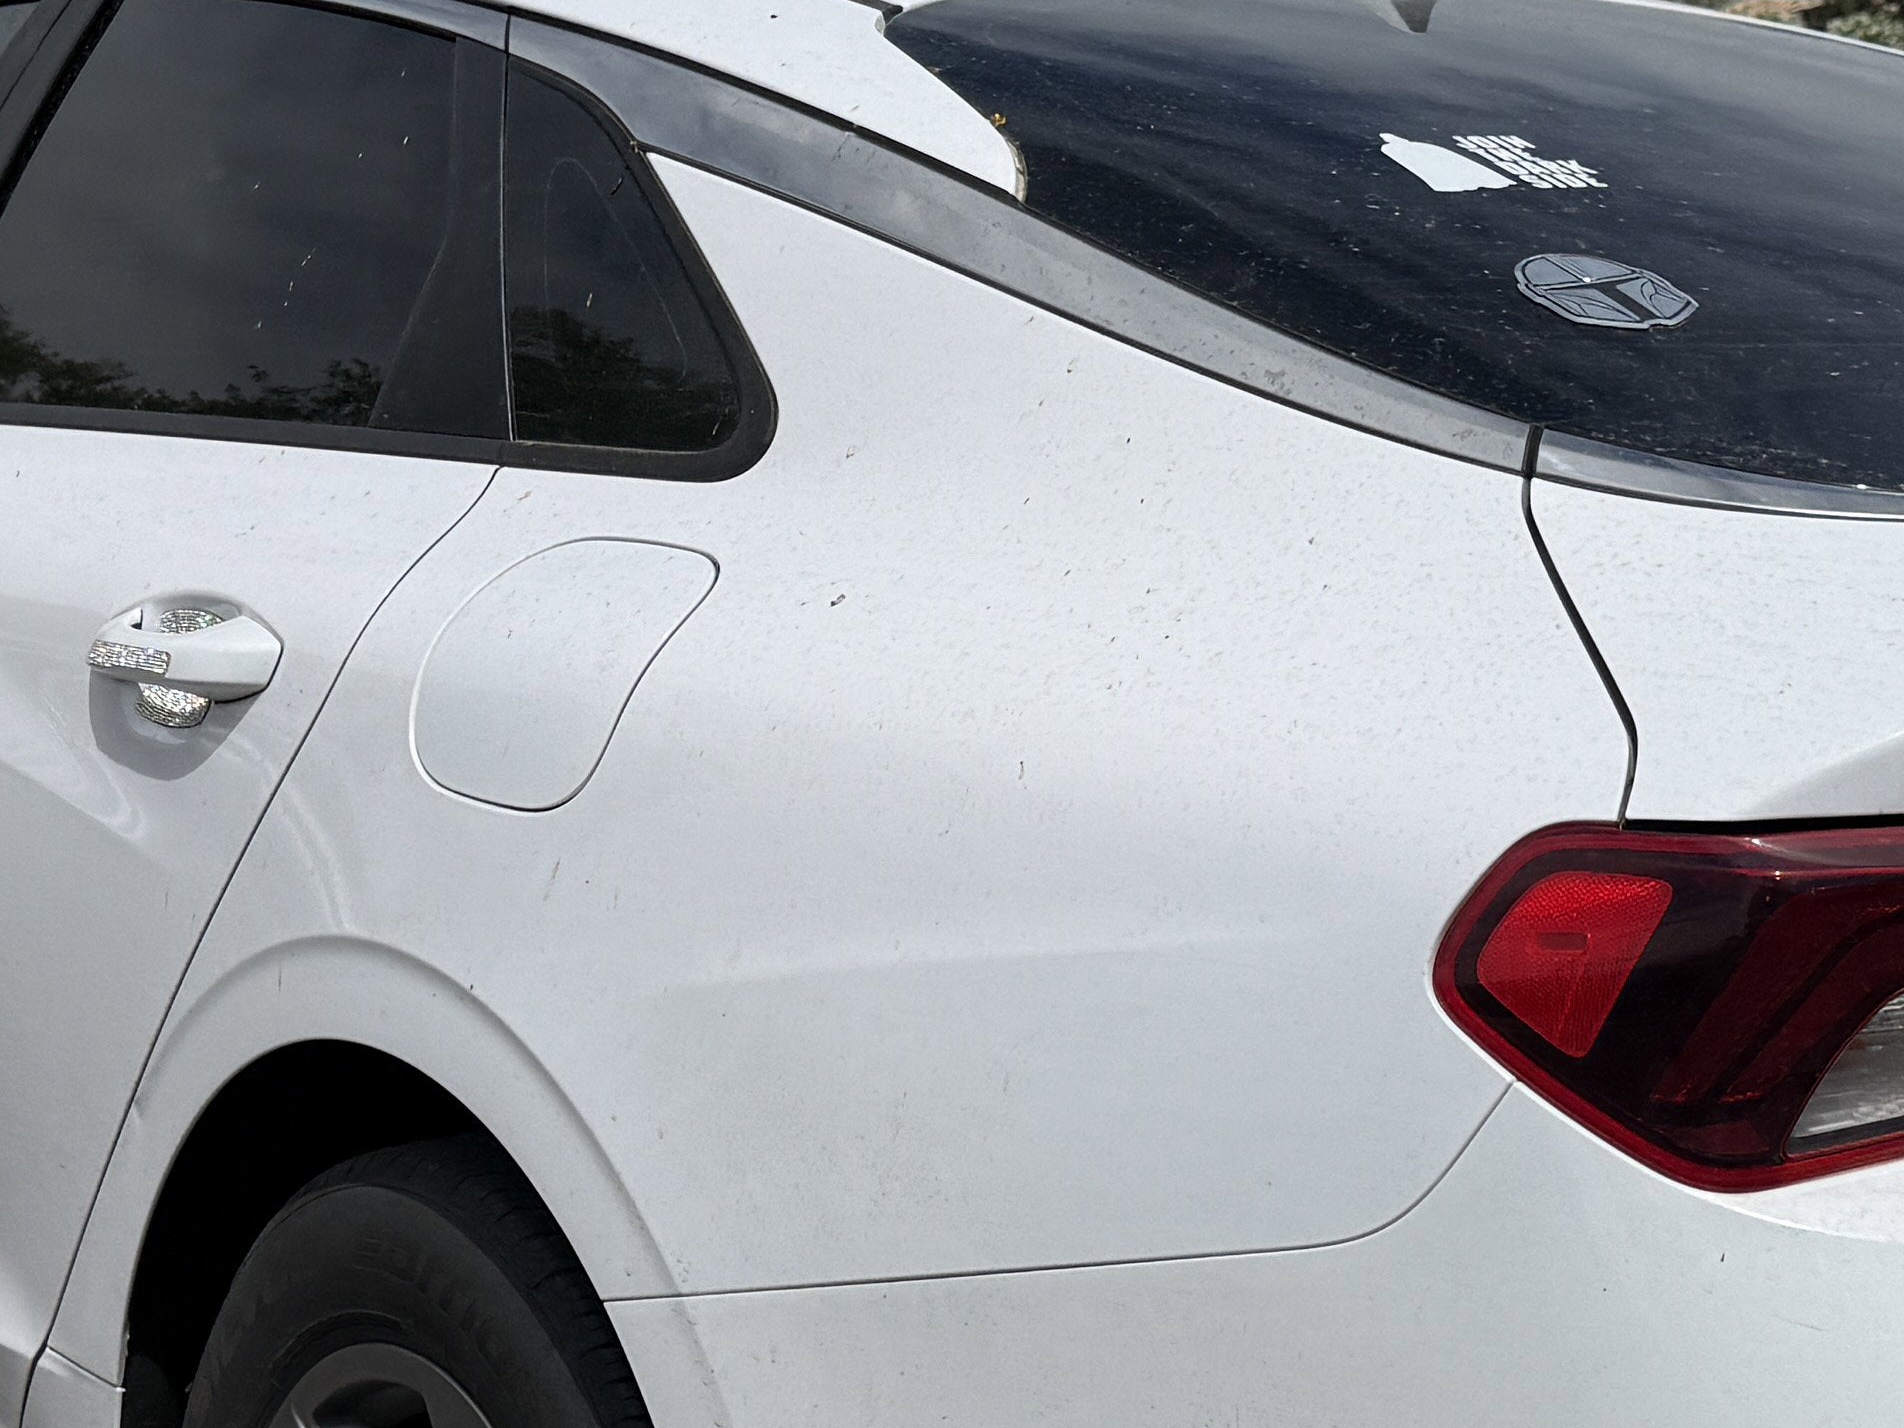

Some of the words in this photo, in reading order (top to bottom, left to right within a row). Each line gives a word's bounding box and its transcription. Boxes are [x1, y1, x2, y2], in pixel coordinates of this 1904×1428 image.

[1452, 134, 1536, 149] JOIN
[1467, 147, 1545, 163] THE
[1493, 159, 1599, 176] DARK
[1518, 173, 1609, 189] SIDE
